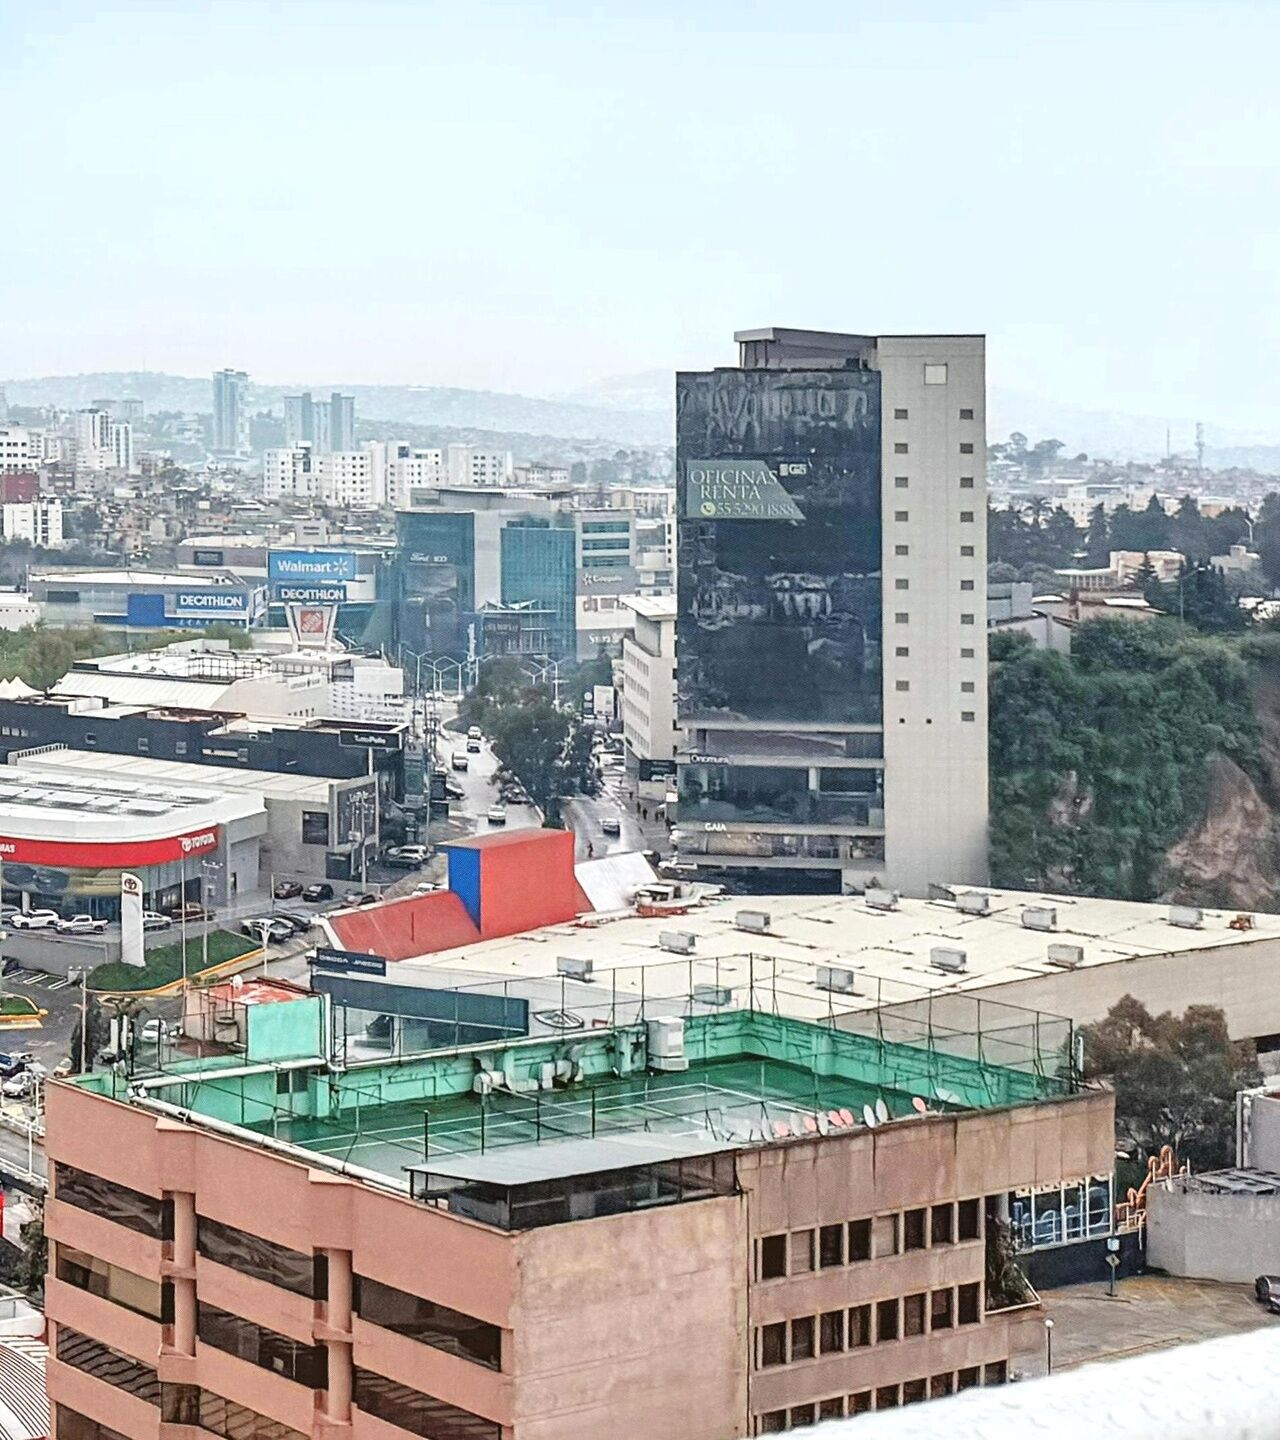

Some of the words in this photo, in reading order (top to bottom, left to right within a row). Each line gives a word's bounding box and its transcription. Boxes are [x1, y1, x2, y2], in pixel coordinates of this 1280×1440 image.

[690, 469, 778, 485] OFICINAS
[701, 485, 761, 499] RENTA
[278, 560, 332, 573] Walmart
[280, 588, 344, 600] DECATHLON
[180, 595, 242, 607] DECATHLON
[705, 822, 727, 831] GAIA
